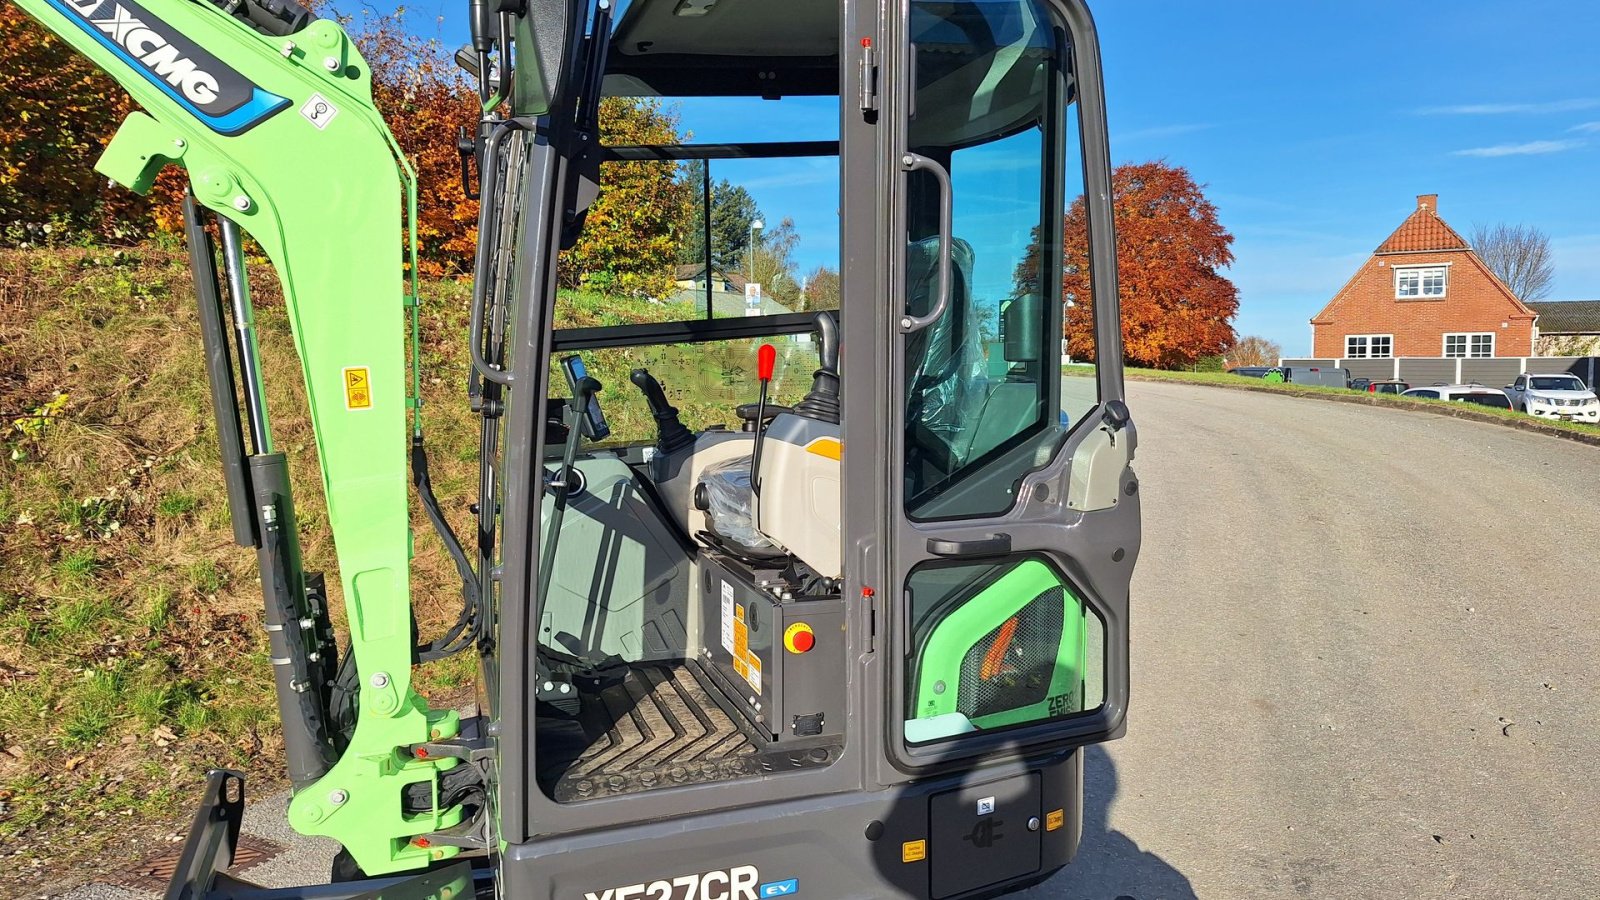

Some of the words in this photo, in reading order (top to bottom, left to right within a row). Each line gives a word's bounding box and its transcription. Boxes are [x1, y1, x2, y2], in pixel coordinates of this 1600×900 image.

[90, 3, 220, 105] XCMG
[1047, 690, 1074, 711] ZERO
[584, 864, 759, 900] 27CR
[766, 882, 791, 895] EV
